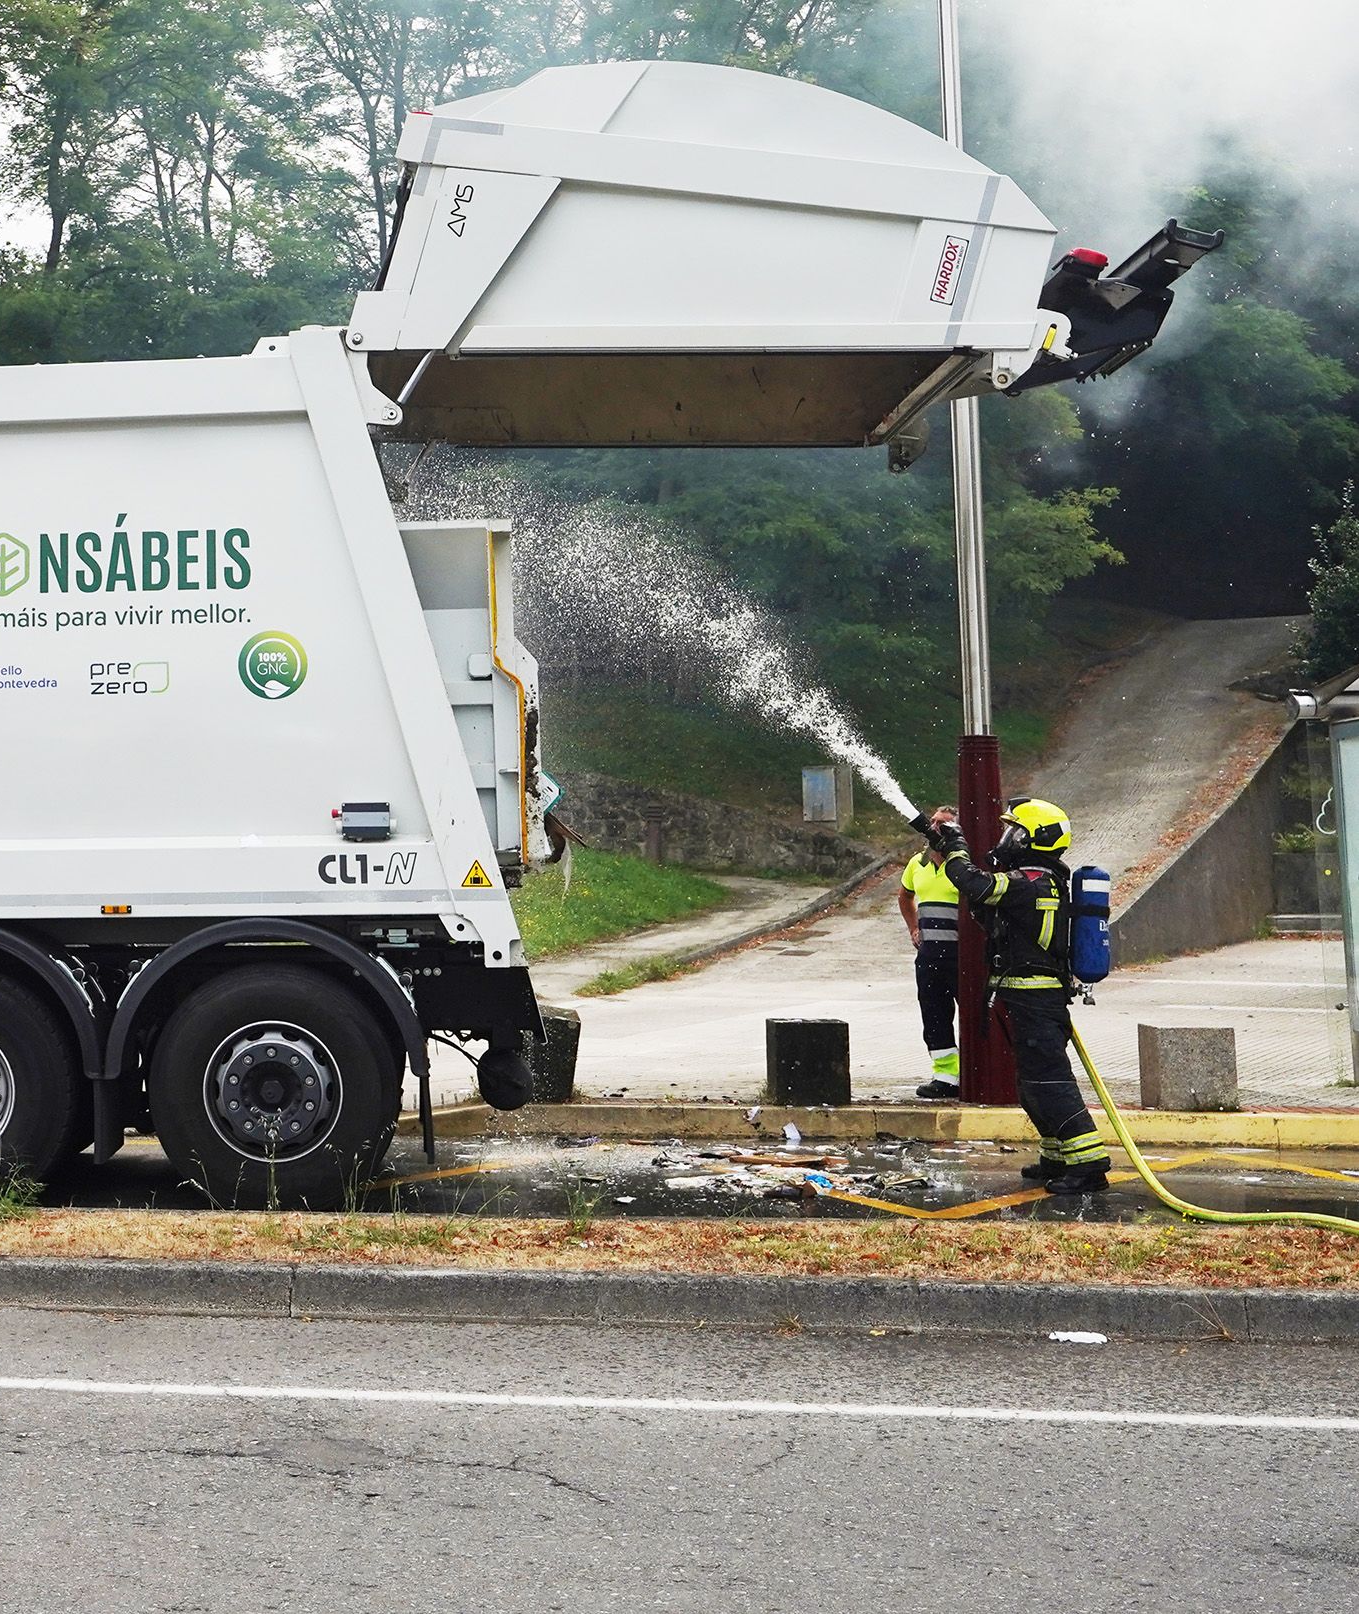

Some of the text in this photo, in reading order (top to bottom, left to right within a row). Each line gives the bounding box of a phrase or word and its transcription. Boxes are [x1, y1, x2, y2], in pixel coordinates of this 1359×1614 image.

[447, 184, 474, 237] AMS
[934, 241, 959, 300] HARDOX
[55, 610, 107, 631] para
[114, 605, 163, 625] vivir
[171, 603, 251, 625] mellor.
[258, 652, 287, 662] 100%
[90, 662, 131, 680] pre
[257, 662, 289, 675] GNC
[91, 681, 148, 695] zero
